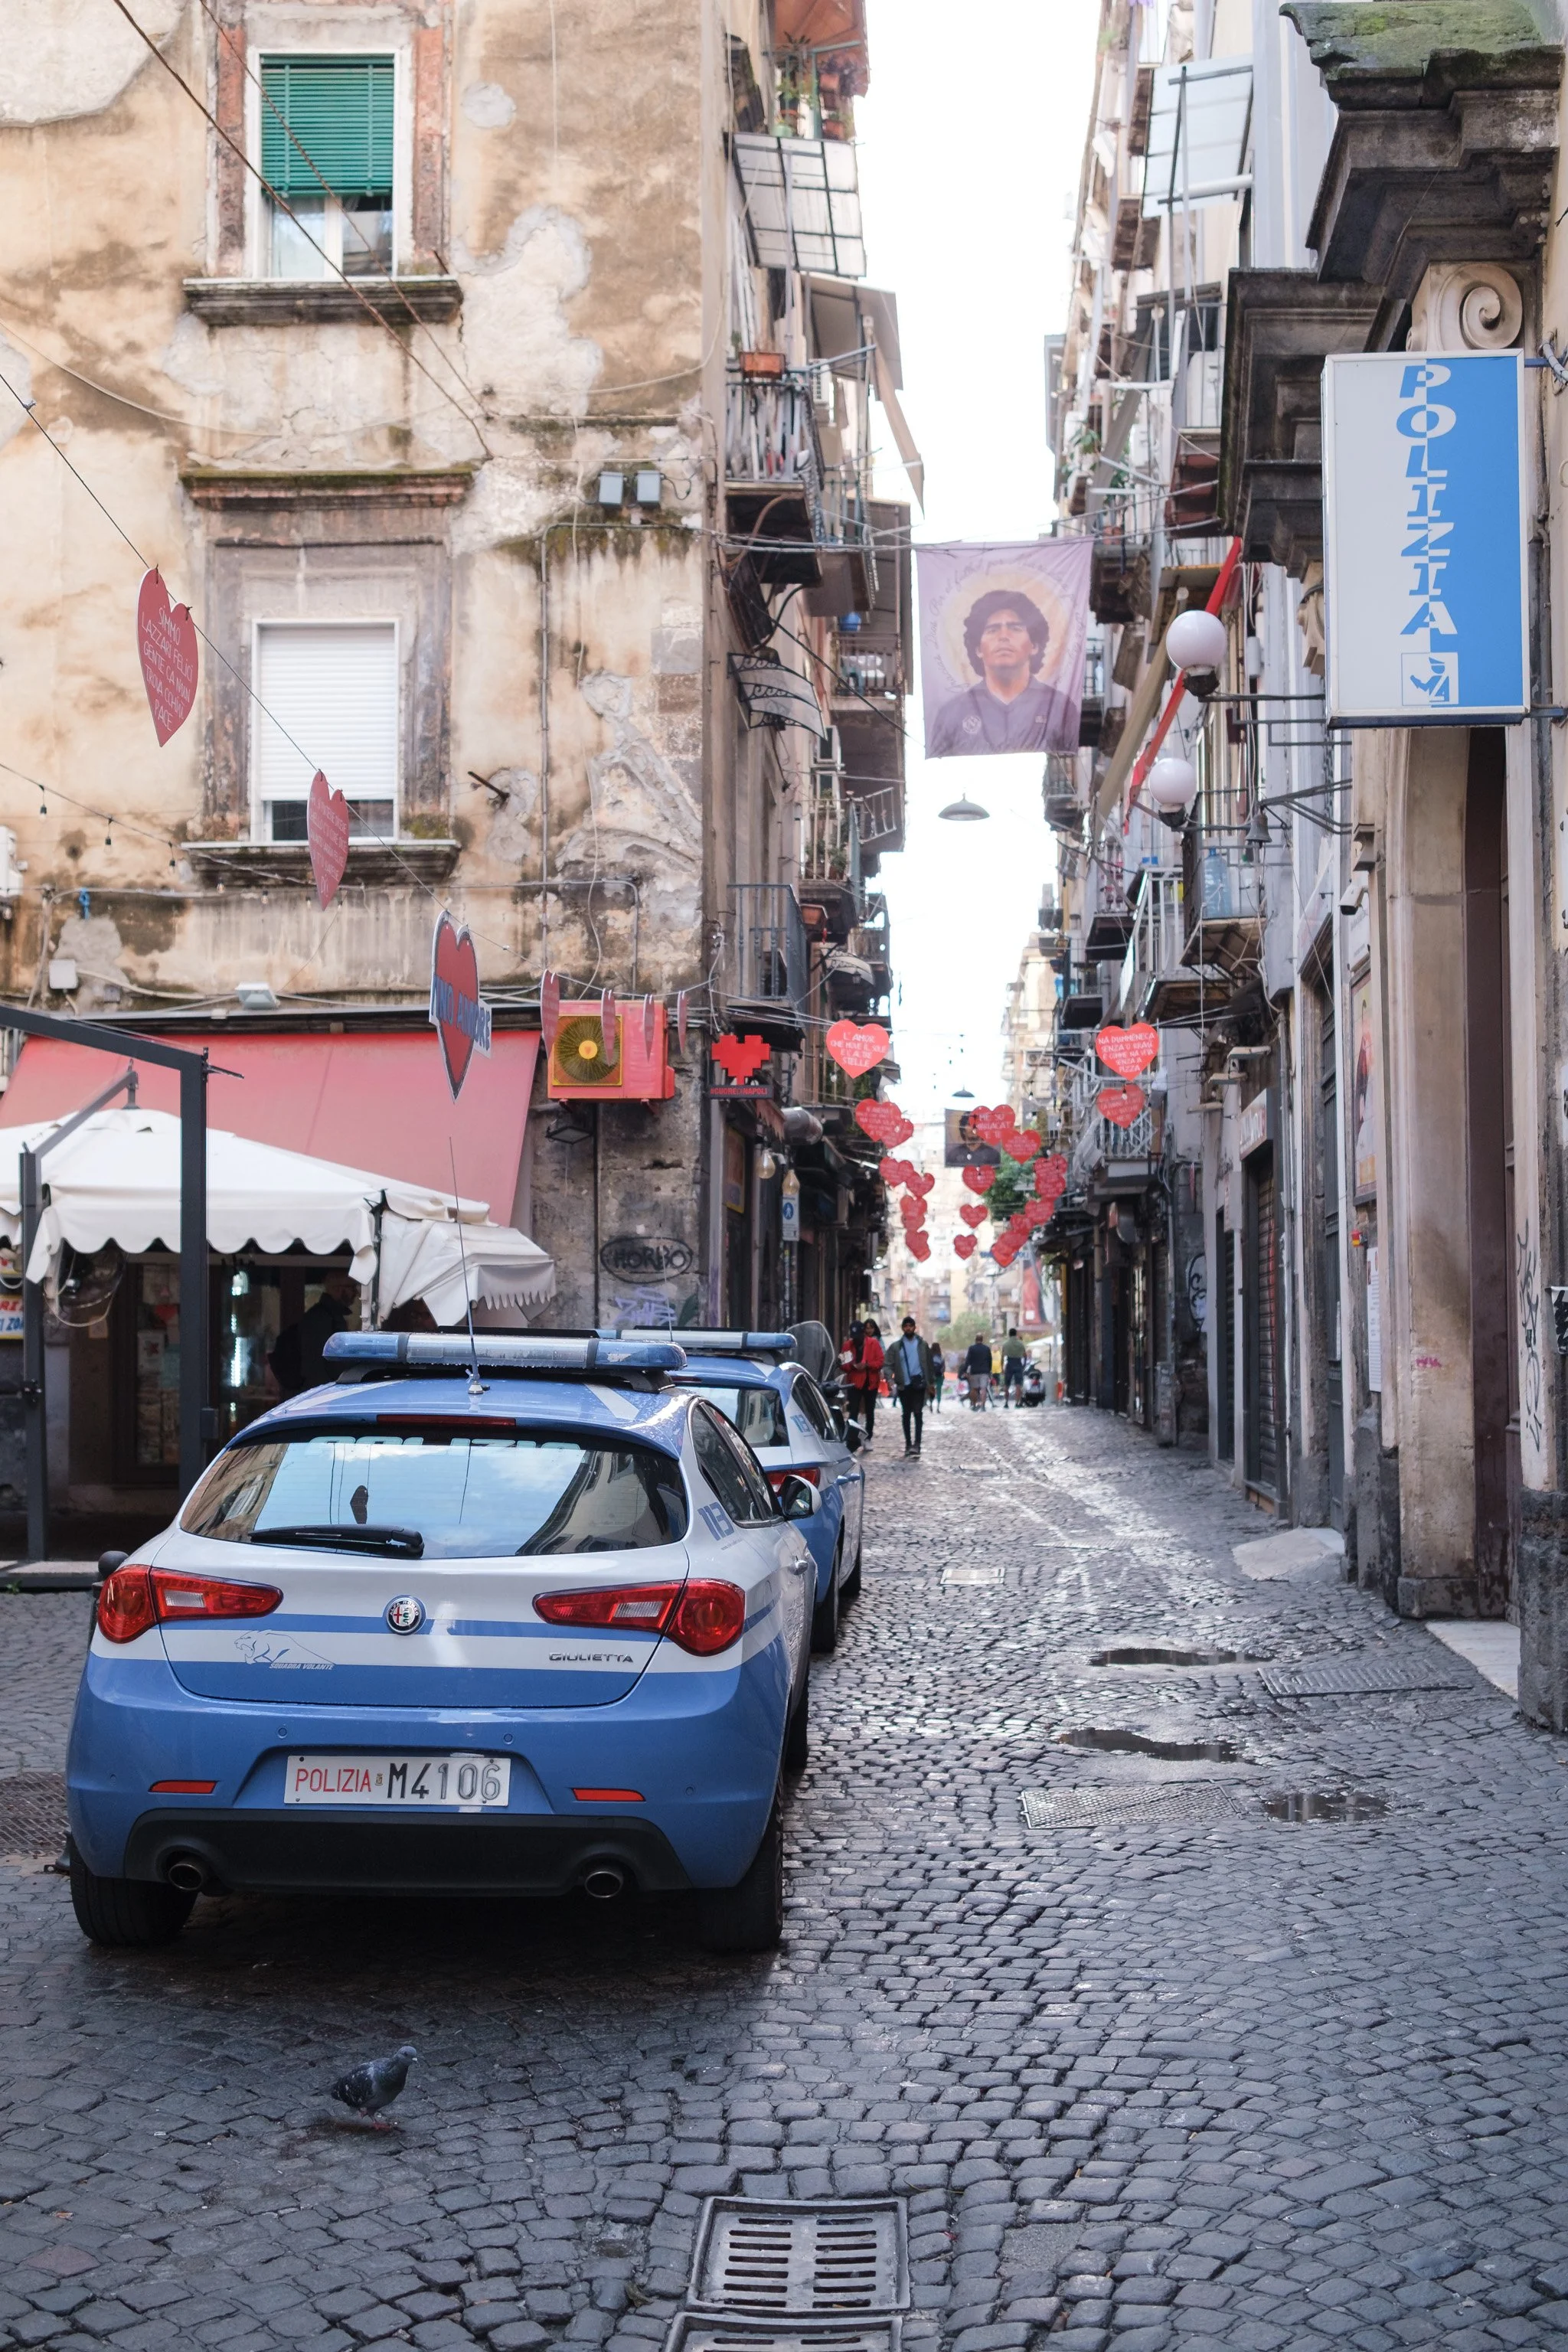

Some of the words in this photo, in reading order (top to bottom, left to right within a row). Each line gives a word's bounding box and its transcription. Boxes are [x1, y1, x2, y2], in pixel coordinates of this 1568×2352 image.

[1396, 364, 1458, 635] POLIZIA
[158, 606, 181, 645] SIMMO
[142, 611, 172, 658] LAZZARI
[173, 648, 193, 682] FELICI
[143, 641, 165, 675] GENTE
[166, 665, 175, 685] CA
[155, 698, 174, 732] PACE
[697, 1501, 735, 1541] 113
[549, 1652, 634, 1663] GIULIETTA
[296, 1769, 371, 1792] POLIZIA
[387, 1762, 501, 1800] M4106
